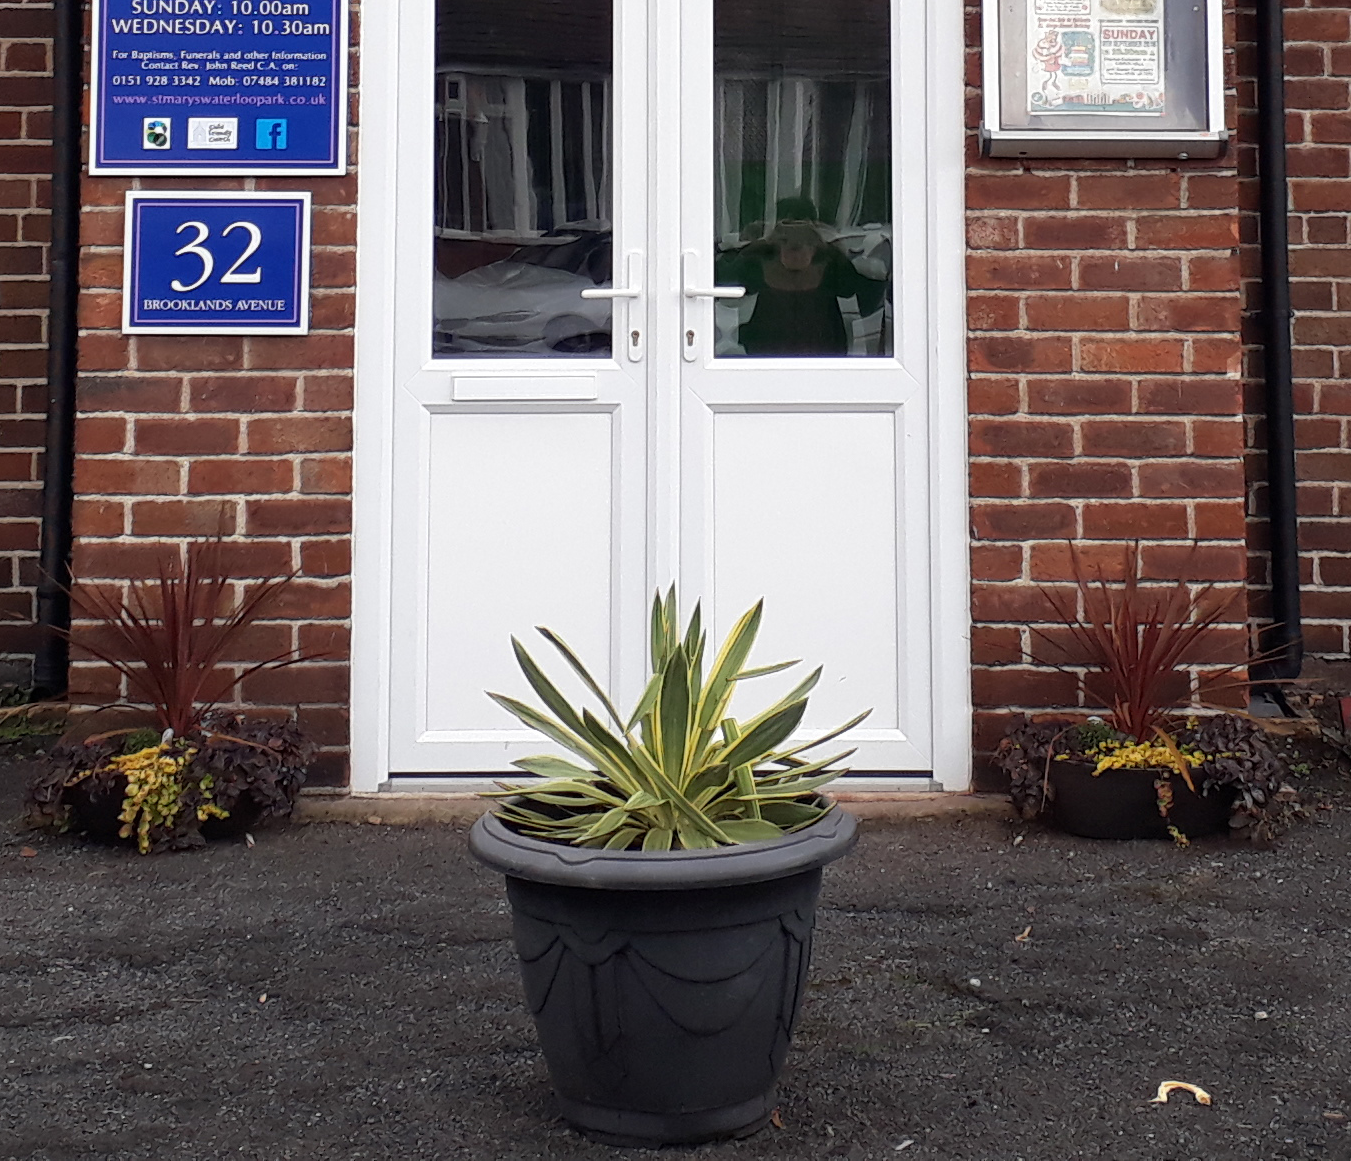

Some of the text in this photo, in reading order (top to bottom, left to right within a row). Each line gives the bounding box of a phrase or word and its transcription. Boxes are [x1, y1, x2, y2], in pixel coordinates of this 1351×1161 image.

[131, 0, 310, 16] SUNDAY: 10.00am
[111, 19, 331, 36] WEDNESDAY: 10.30am
[1102, 29, 1156, 39] SUNDAY
[112, 50, 327, 62] For Baptisms, Funerals and other Information
[141, 61, 299, 71] Contact Rev. John Reed C.A. on:
[112, 75, 326, 87] 0151 928 3342 Mob: 07484 381182
[112, 93, 327, 107] www.stmaryswaterloopark.co.uk
[170, 221, 262, 292] 32
[143, 299, 286, 311] BROOKLANDS AVENUE
